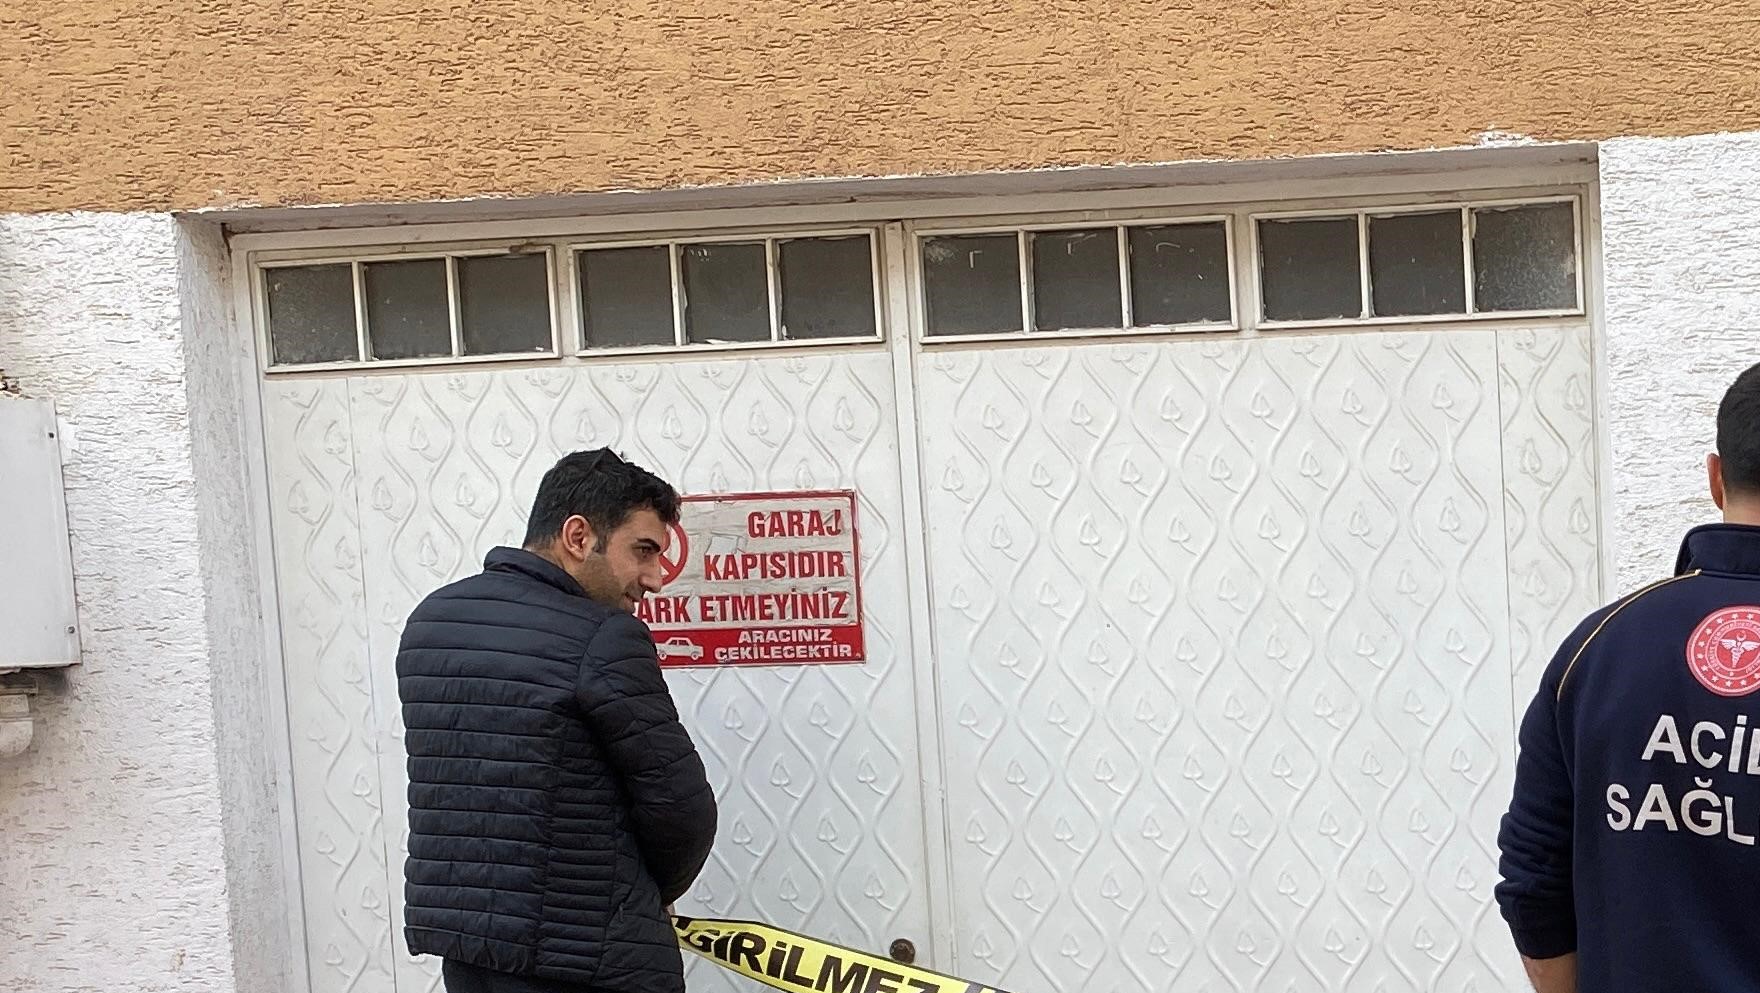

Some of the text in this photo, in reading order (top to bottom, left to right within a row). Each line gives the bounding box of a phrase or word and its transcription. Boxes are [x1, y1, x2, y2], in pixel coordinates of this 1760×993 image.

[747, 509, 842, 539] GARAJ
[704, 551, 845, 581] KAPISIDIR
[636, 587, 850, 624] ARK ETMEYİNİZ
[738, 628, 833, 645] ARACINIZ
